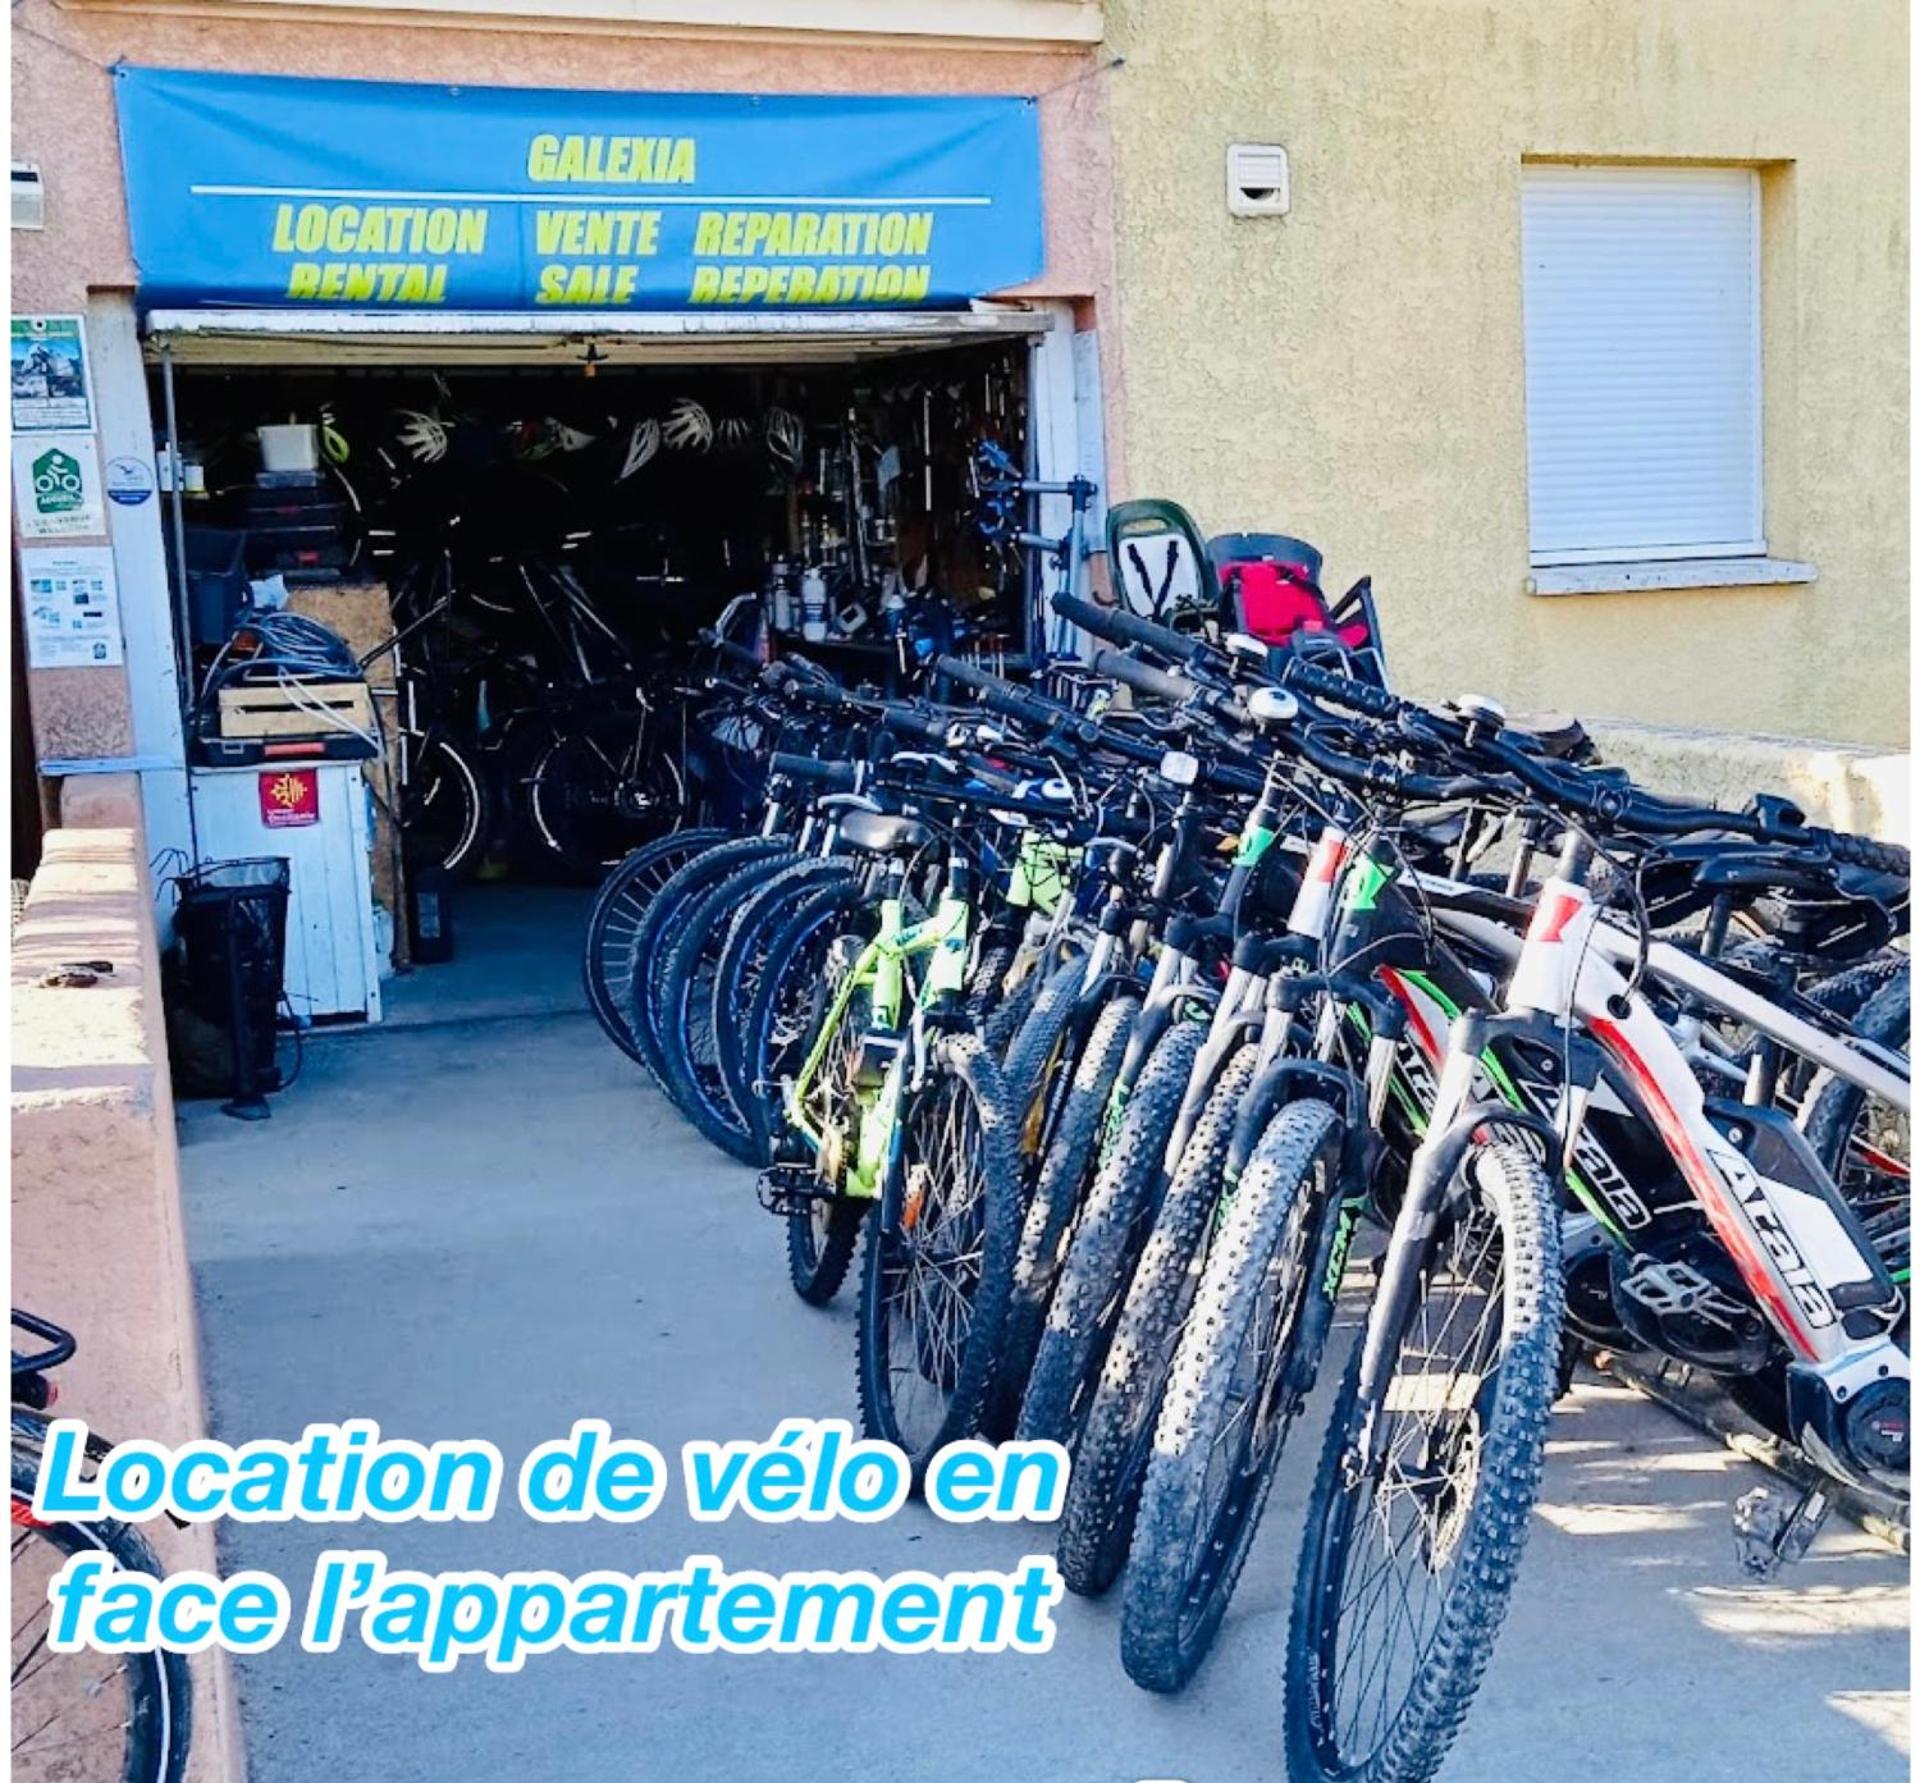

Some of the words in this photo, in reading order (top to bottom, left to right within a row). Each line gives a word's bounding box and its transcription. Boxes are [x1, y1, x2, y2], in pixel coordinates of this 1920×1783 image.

[527, 133, 696, 184] GALEXIA
[272, 203, 488, 254] LOCATION
[535, 209, 661, 255] VENTE
[693, 211, 933, 256] REPARATION
[287, 262, 448, 303] RENTAL
[535, 264, 639, 304] SALE
